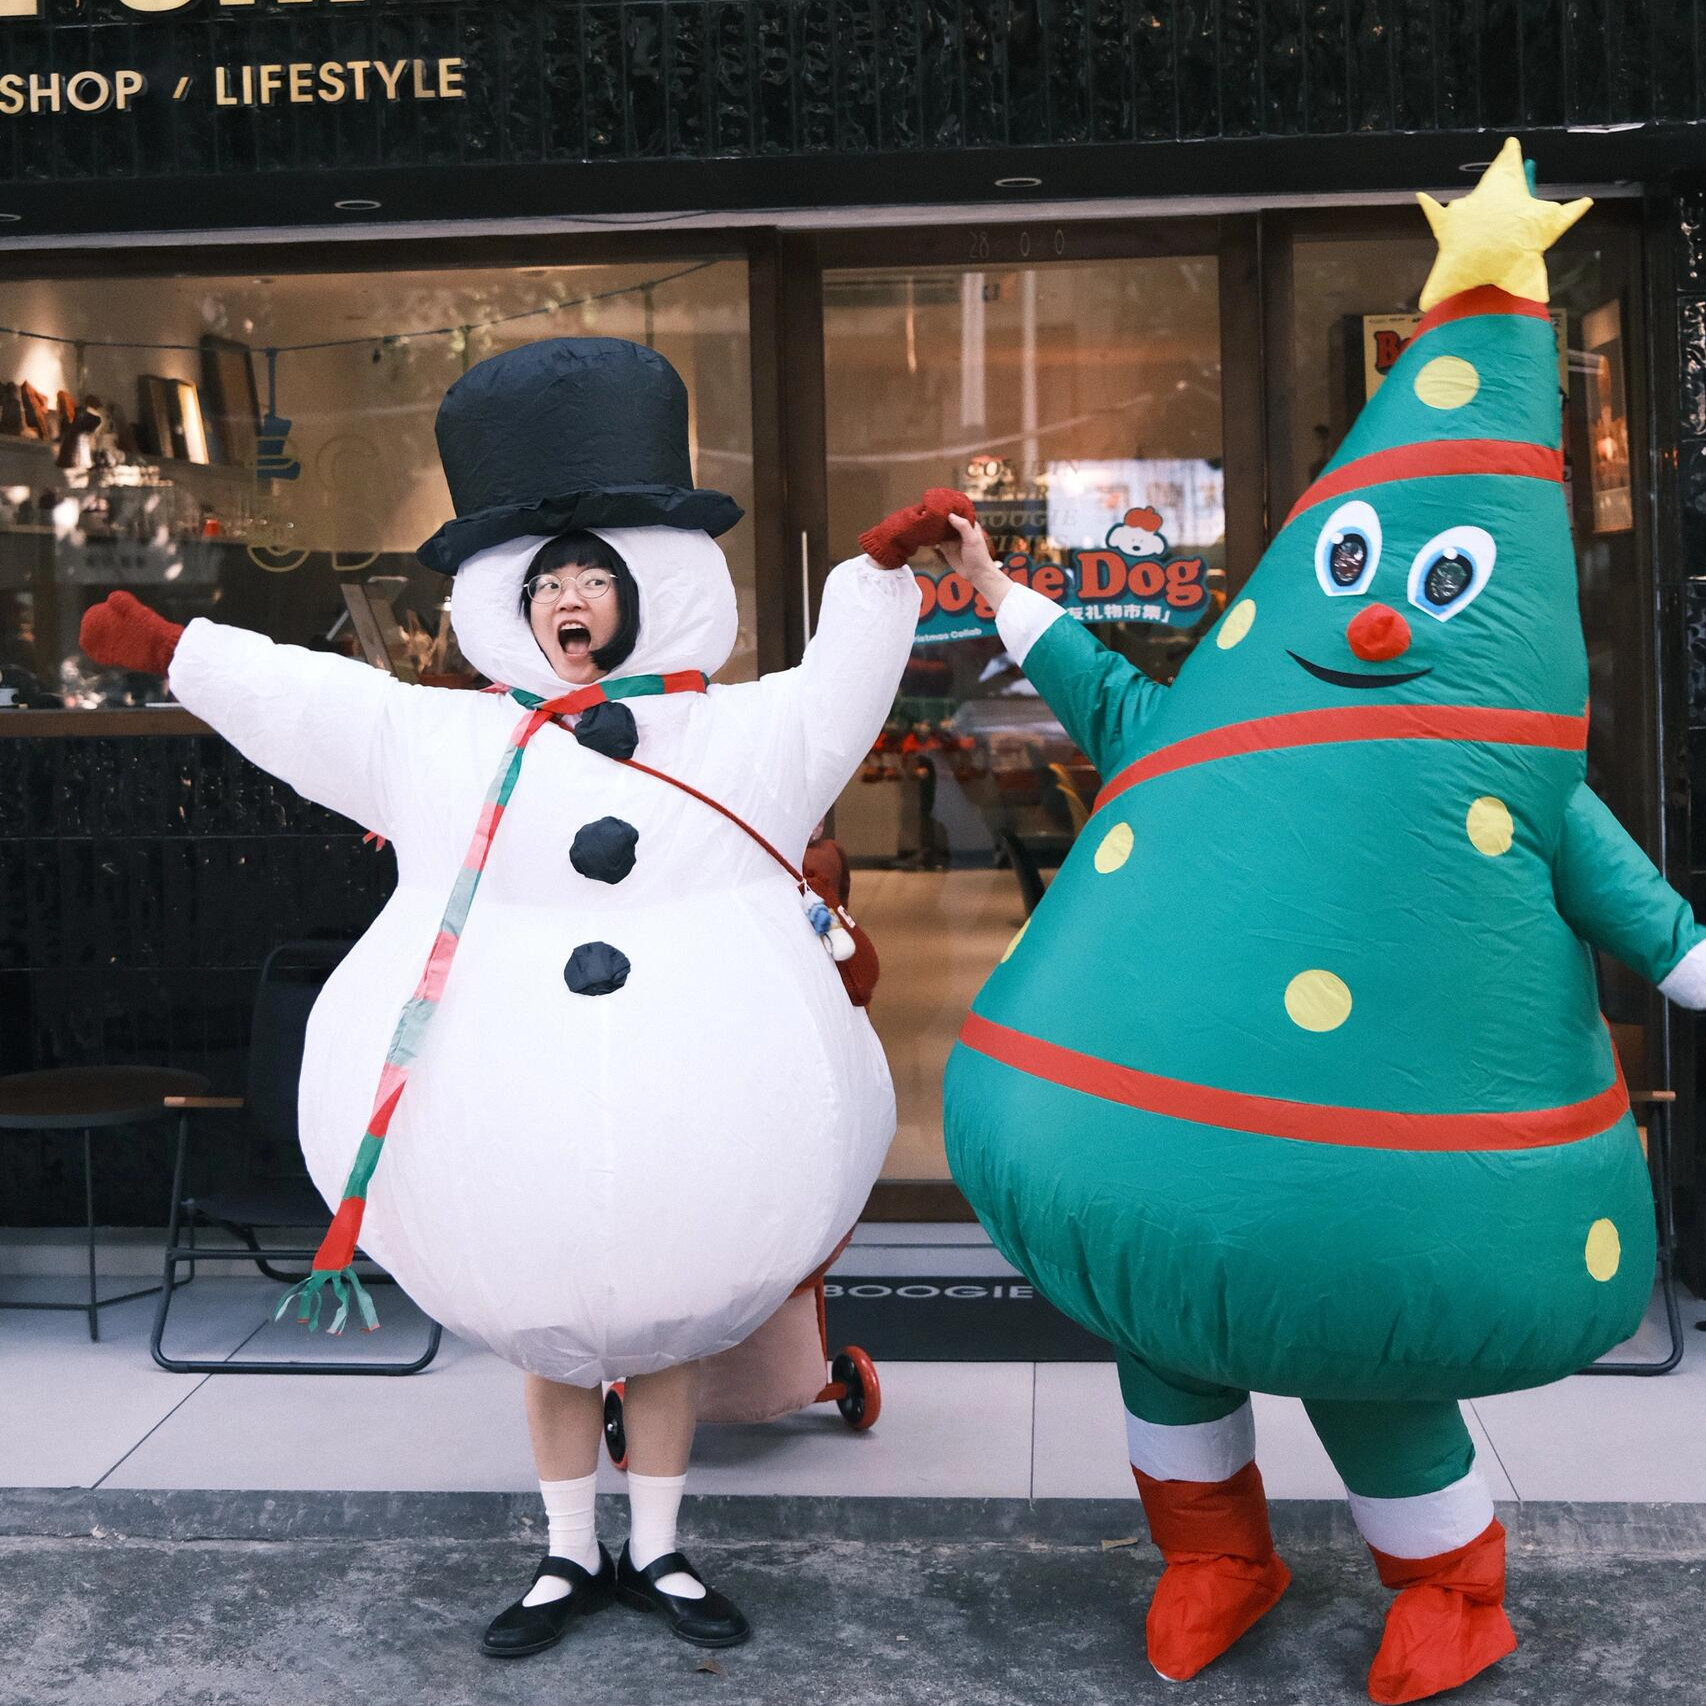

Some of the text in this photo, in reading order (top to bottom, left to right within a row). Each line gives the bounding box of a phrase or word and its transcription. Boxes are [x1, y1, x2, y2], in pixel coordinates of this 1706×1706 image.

[0, 71, 143, 113] SHOP
[215, 58, 463, 106] LIFESTYLE
[1077, 550, 1204, 607] Dog
[823, 1284, 1033, 1299] BOOGIE
